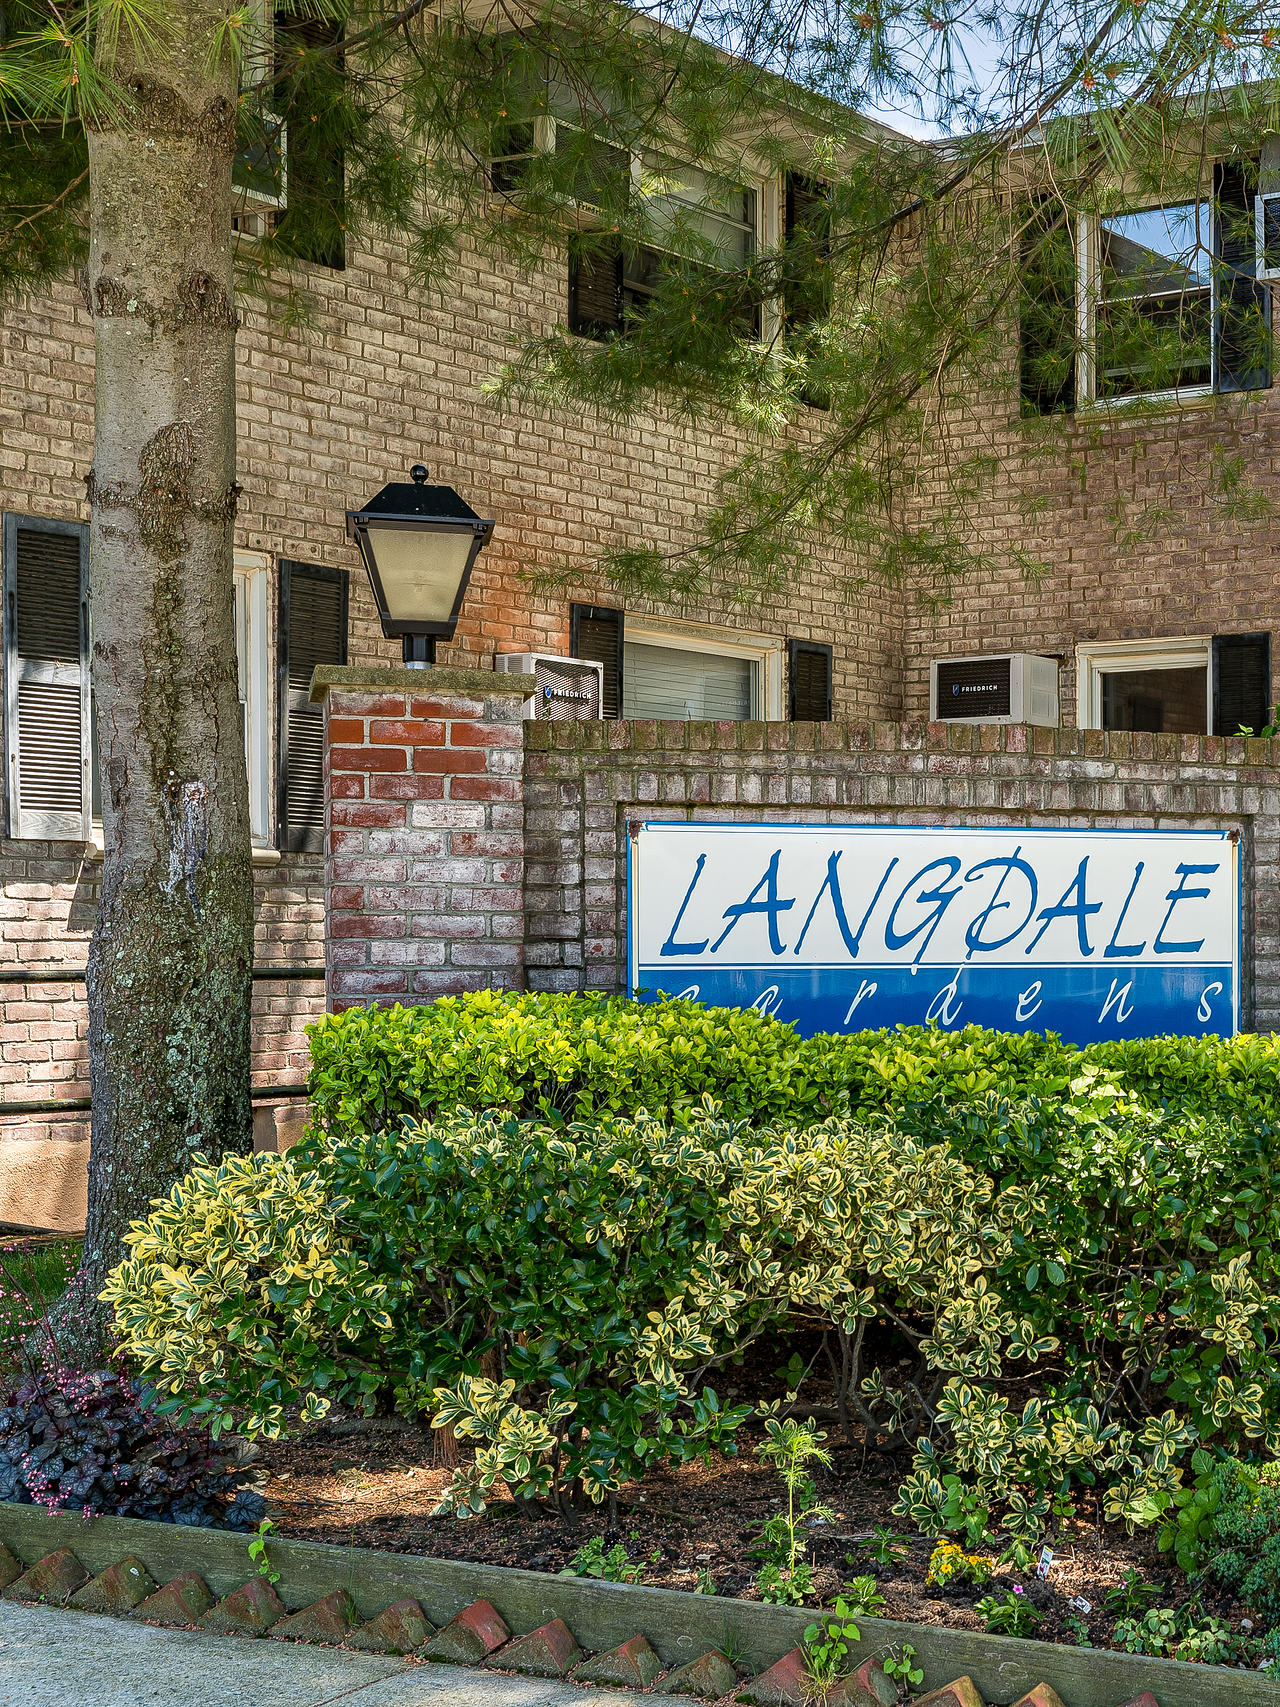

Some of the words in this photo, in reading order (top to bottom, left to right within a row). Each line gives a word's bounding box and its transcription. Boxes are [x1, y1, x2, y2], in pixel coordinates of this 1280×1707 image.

[961, 684, 998, 693] FRIEDRICH
[553, 689, 592, 700] FRIEDRICH
[659, 845, 1221, 975] LANGDALE
